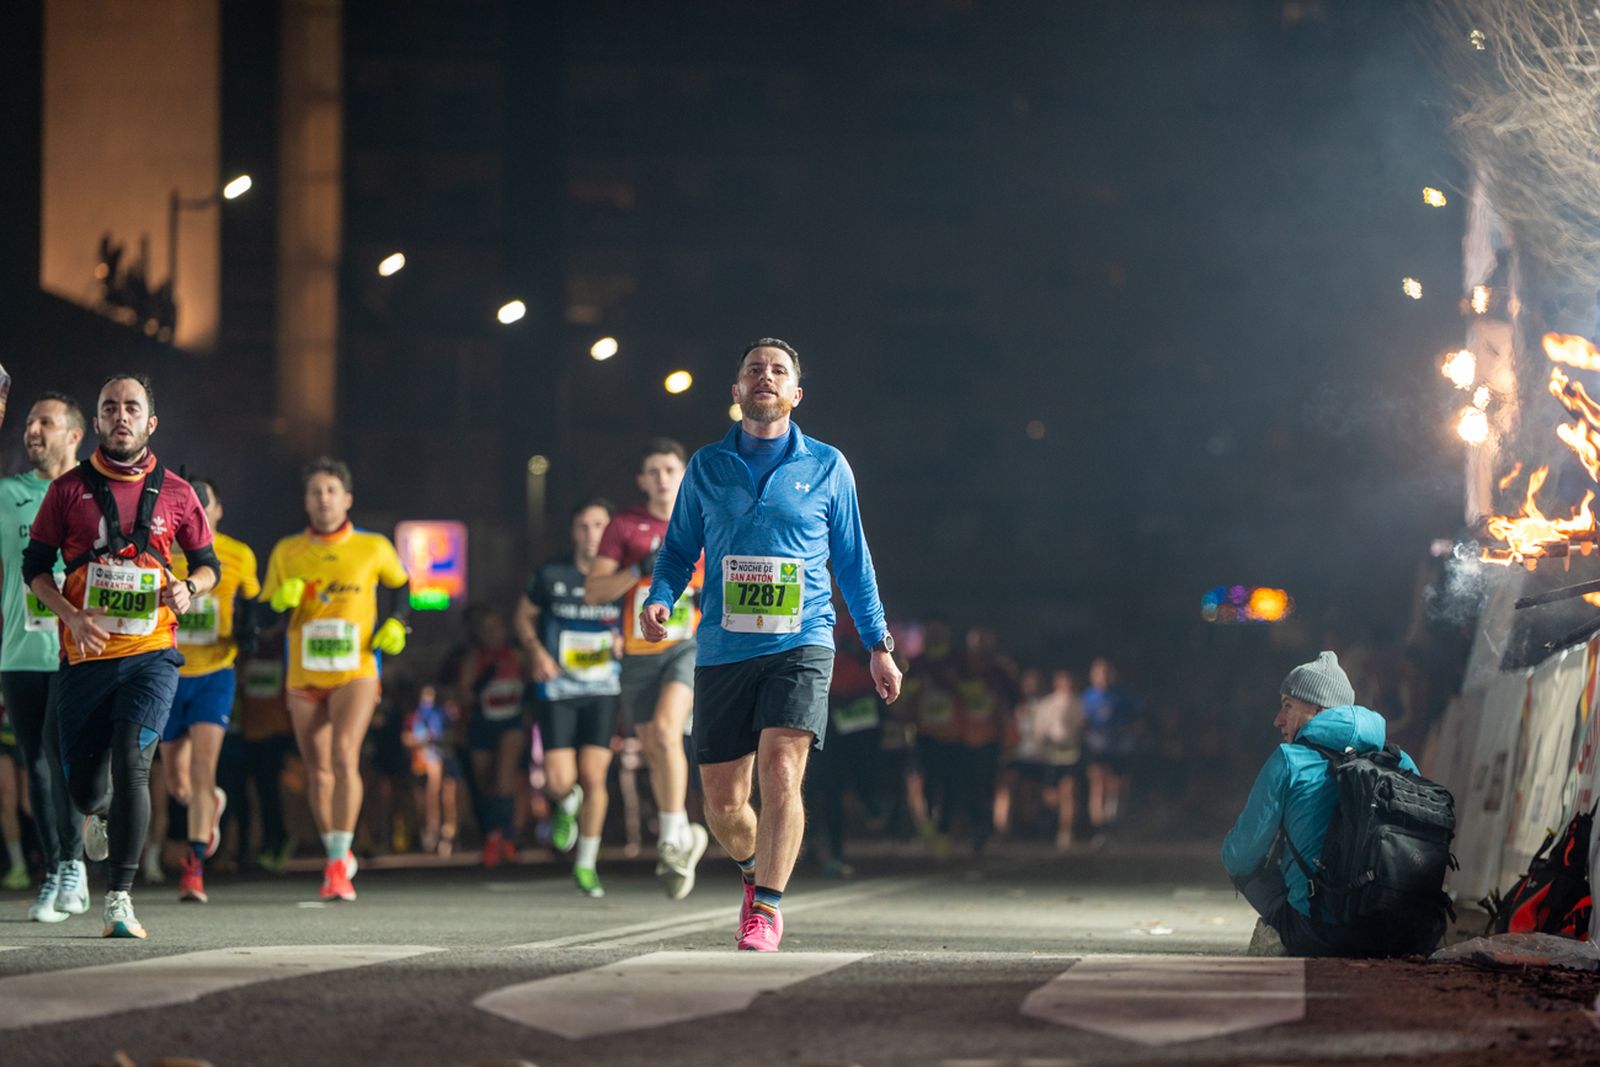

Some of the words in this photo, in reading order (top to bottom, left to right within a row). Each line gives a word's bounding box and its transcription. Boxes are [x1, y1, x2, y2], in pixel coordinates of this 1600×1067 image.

[763, 565, 773, 573] DE
[730, 573, 745, 582] SAN
[98, 588, 147, 612] 8209
[738, 584, 786, 607] 7287
